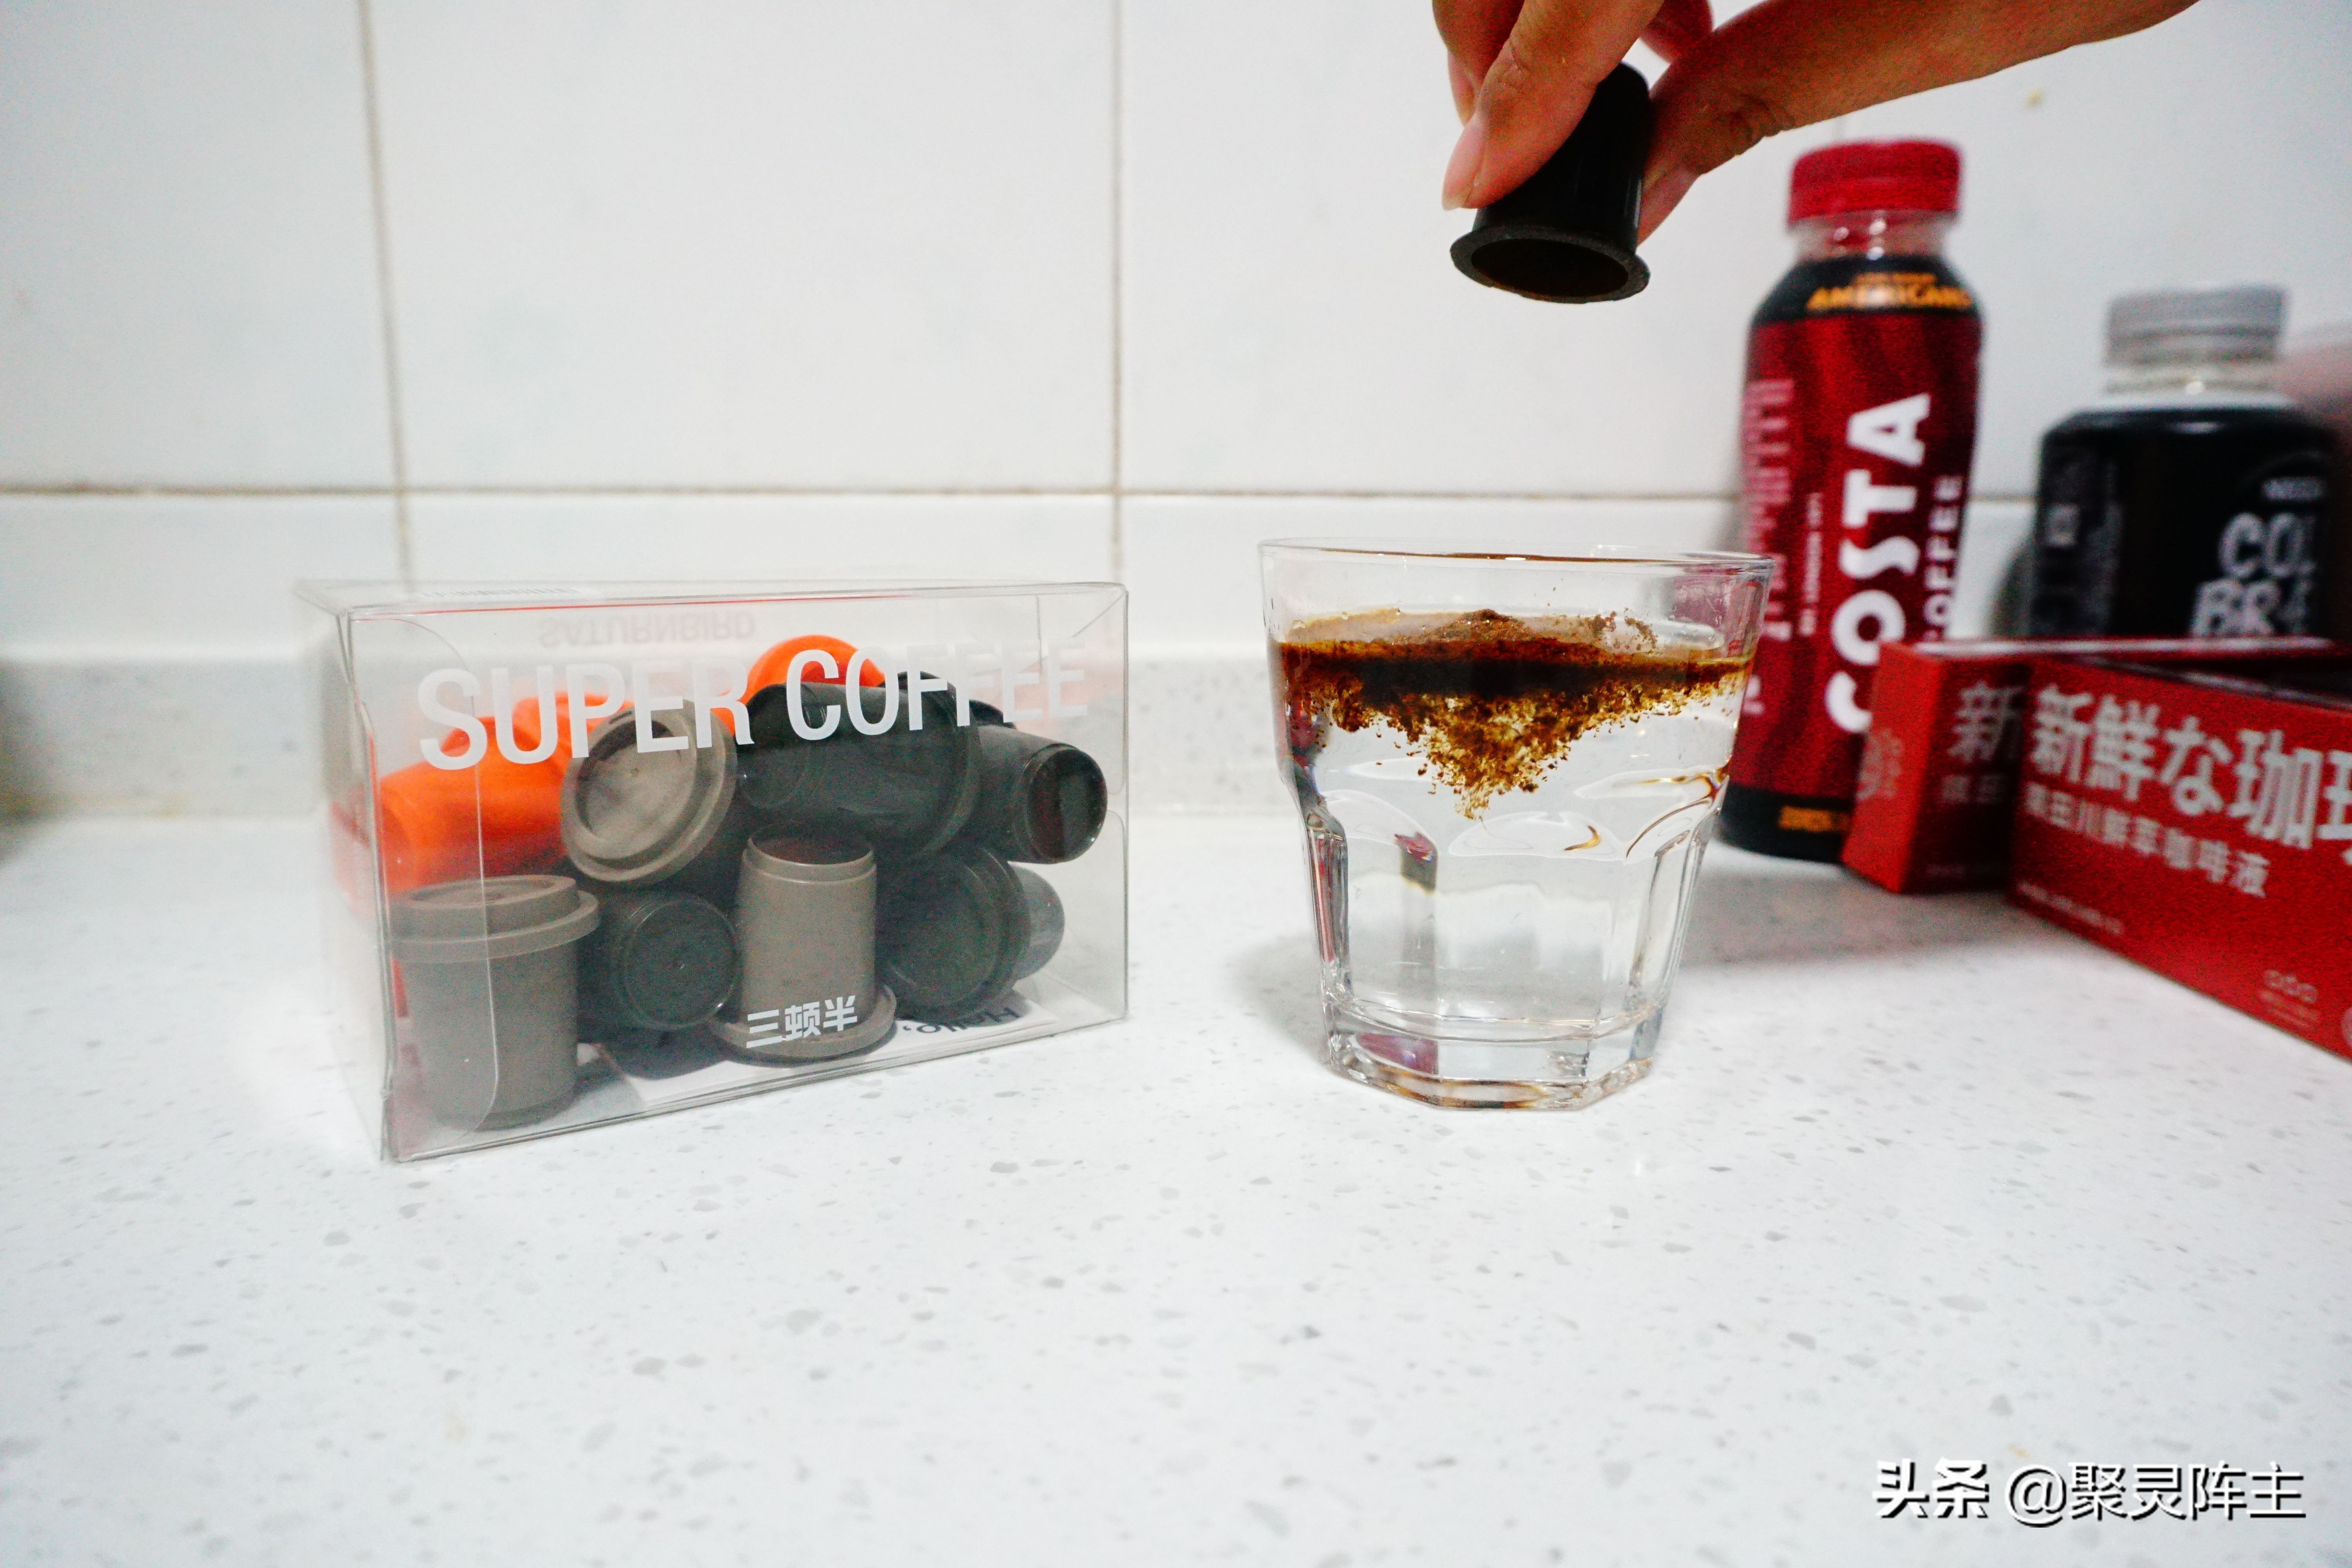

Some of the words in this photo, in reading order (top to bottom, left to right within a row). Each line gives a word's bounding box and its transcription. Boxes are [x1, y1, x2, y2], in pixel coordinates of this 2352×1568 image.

[1825, 392, 1931, 733] COSTA
[417, 659, 755, 770] SUPER
[786, 638, 1088, 740] COFFEE
[746, 995, 858, 1048] 三顿半
